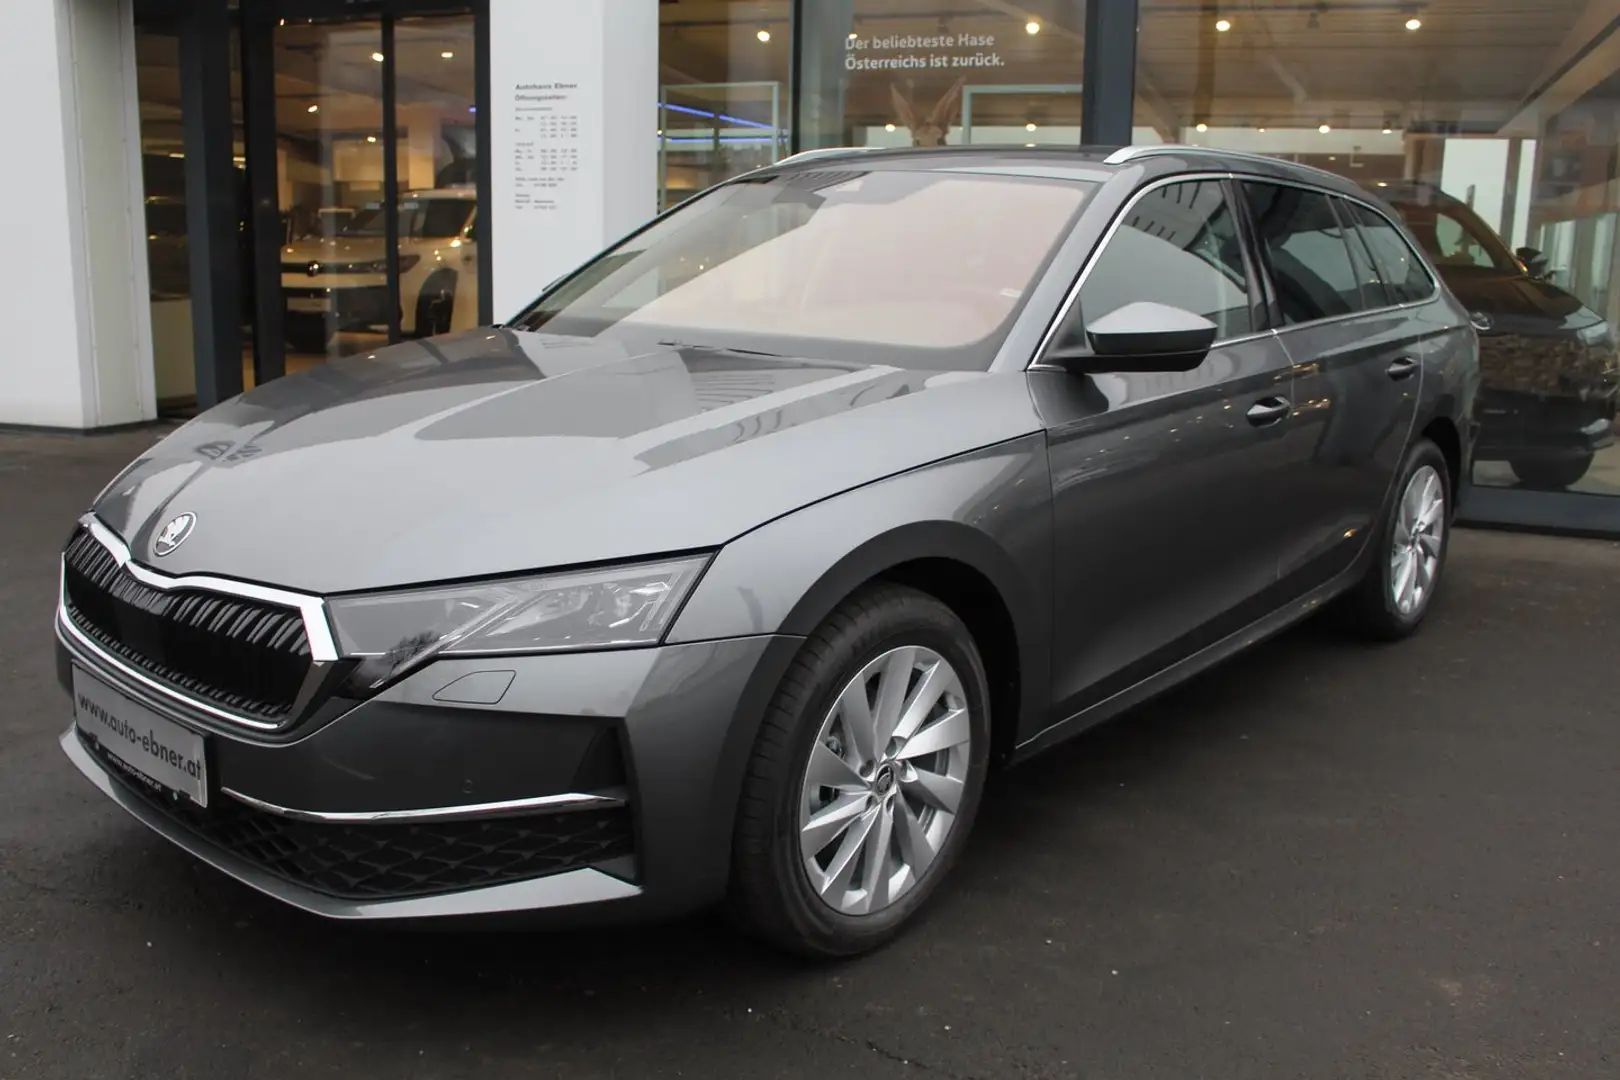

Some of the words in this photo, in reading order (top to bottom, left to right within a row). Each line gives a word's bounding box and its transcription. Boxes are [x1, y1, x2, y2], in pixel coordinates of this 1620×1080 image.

[845, 35, 870, 50] Der
[872, 35, 954, 49] beliebteste
[957, 33, 995, 47] Hase
[845, 53, 926, 70] Österreichs
[930, 54, 948, 68] ist
[952, 52, 1005, 67] zurück.
[78, 692, 202, 780] www.auto-ebner.at
